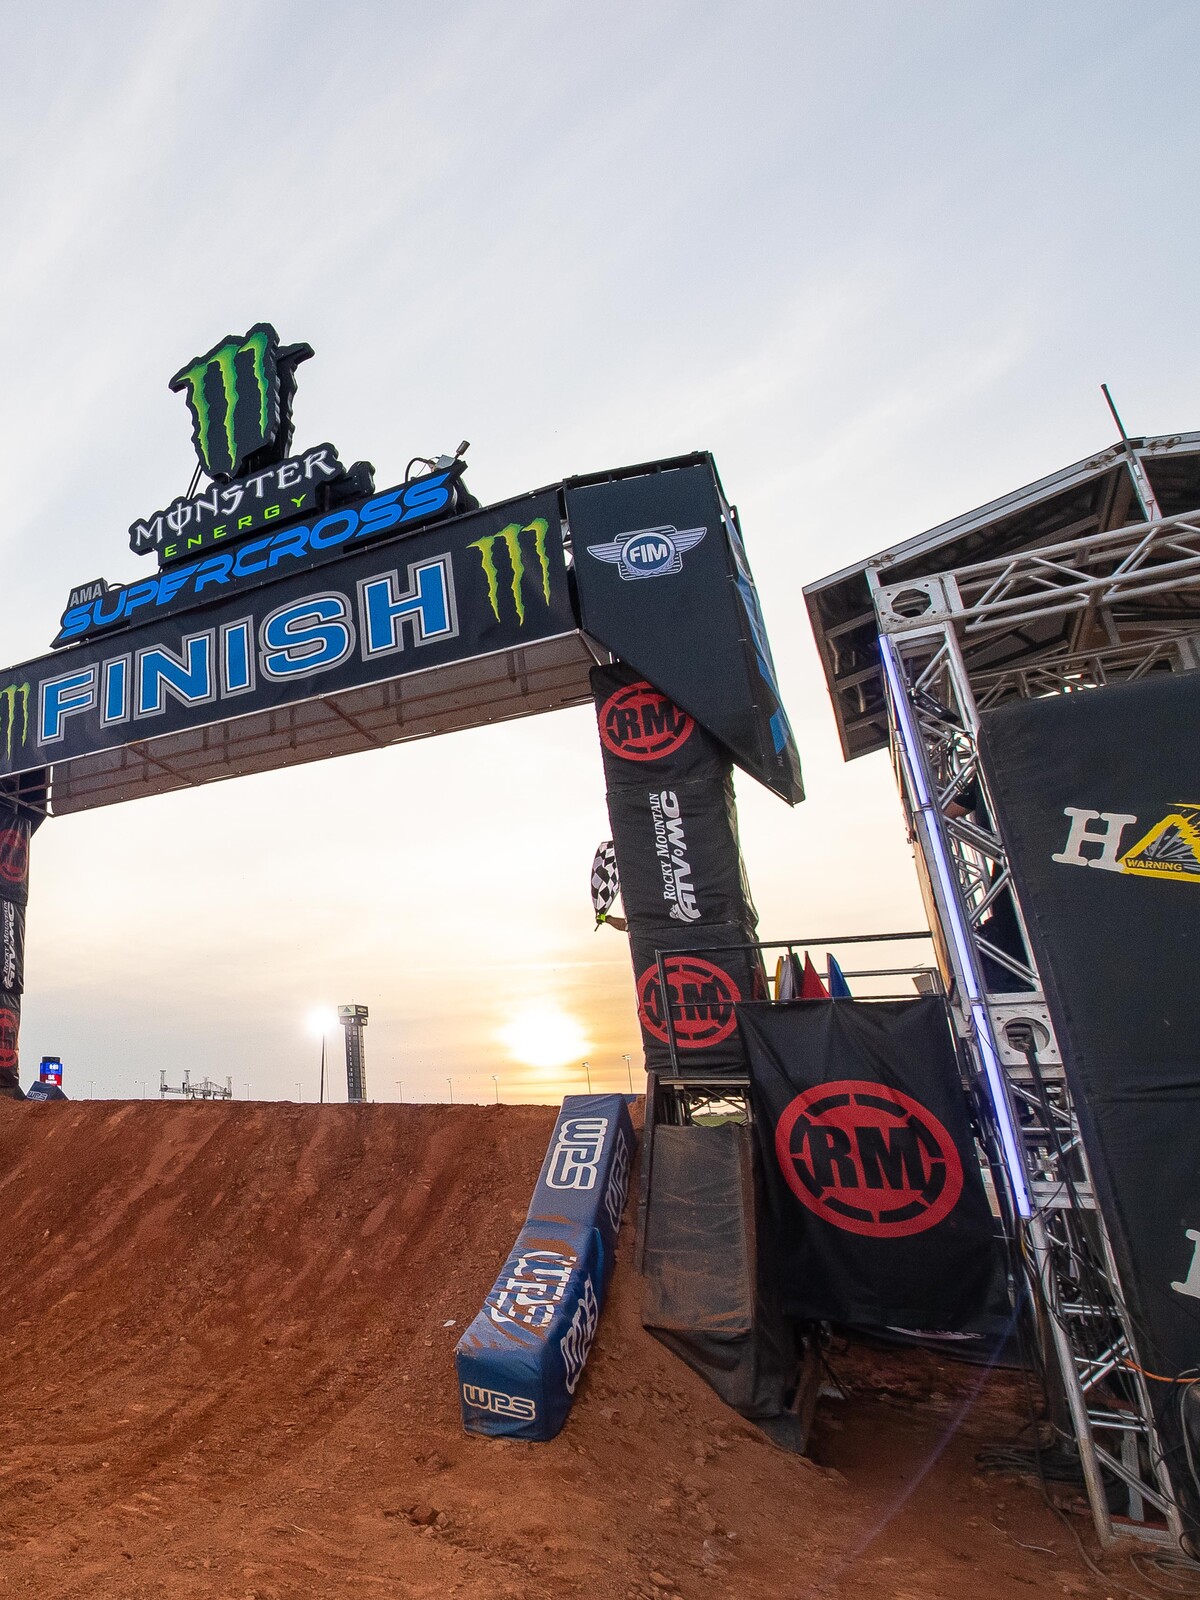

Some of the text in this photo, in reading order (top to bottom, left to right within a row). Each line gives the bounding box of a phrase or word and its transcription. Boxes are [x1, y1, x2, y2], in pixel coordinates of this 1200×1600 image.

[134, 449, 337, 547] MONSTER
[164, 494, 308, 558] ENERGY
[59, 472, 452, 639] SUPERCROSS
[629, 543, 668, 564] FIM
[69, 581, 103, 608] AMA
[37, 552, 459, 747] FINISH
[615, 702, 677, 741] RM
[648, 792, 676, 901] ROCKY MOUNTAIN
[1126, 858, 1183, 871] WARNING
[545, 1117, 609, 1190] WPS
[805, 1124, 928, 1191] RM
[462, 1383, 536, 1422] WPS
